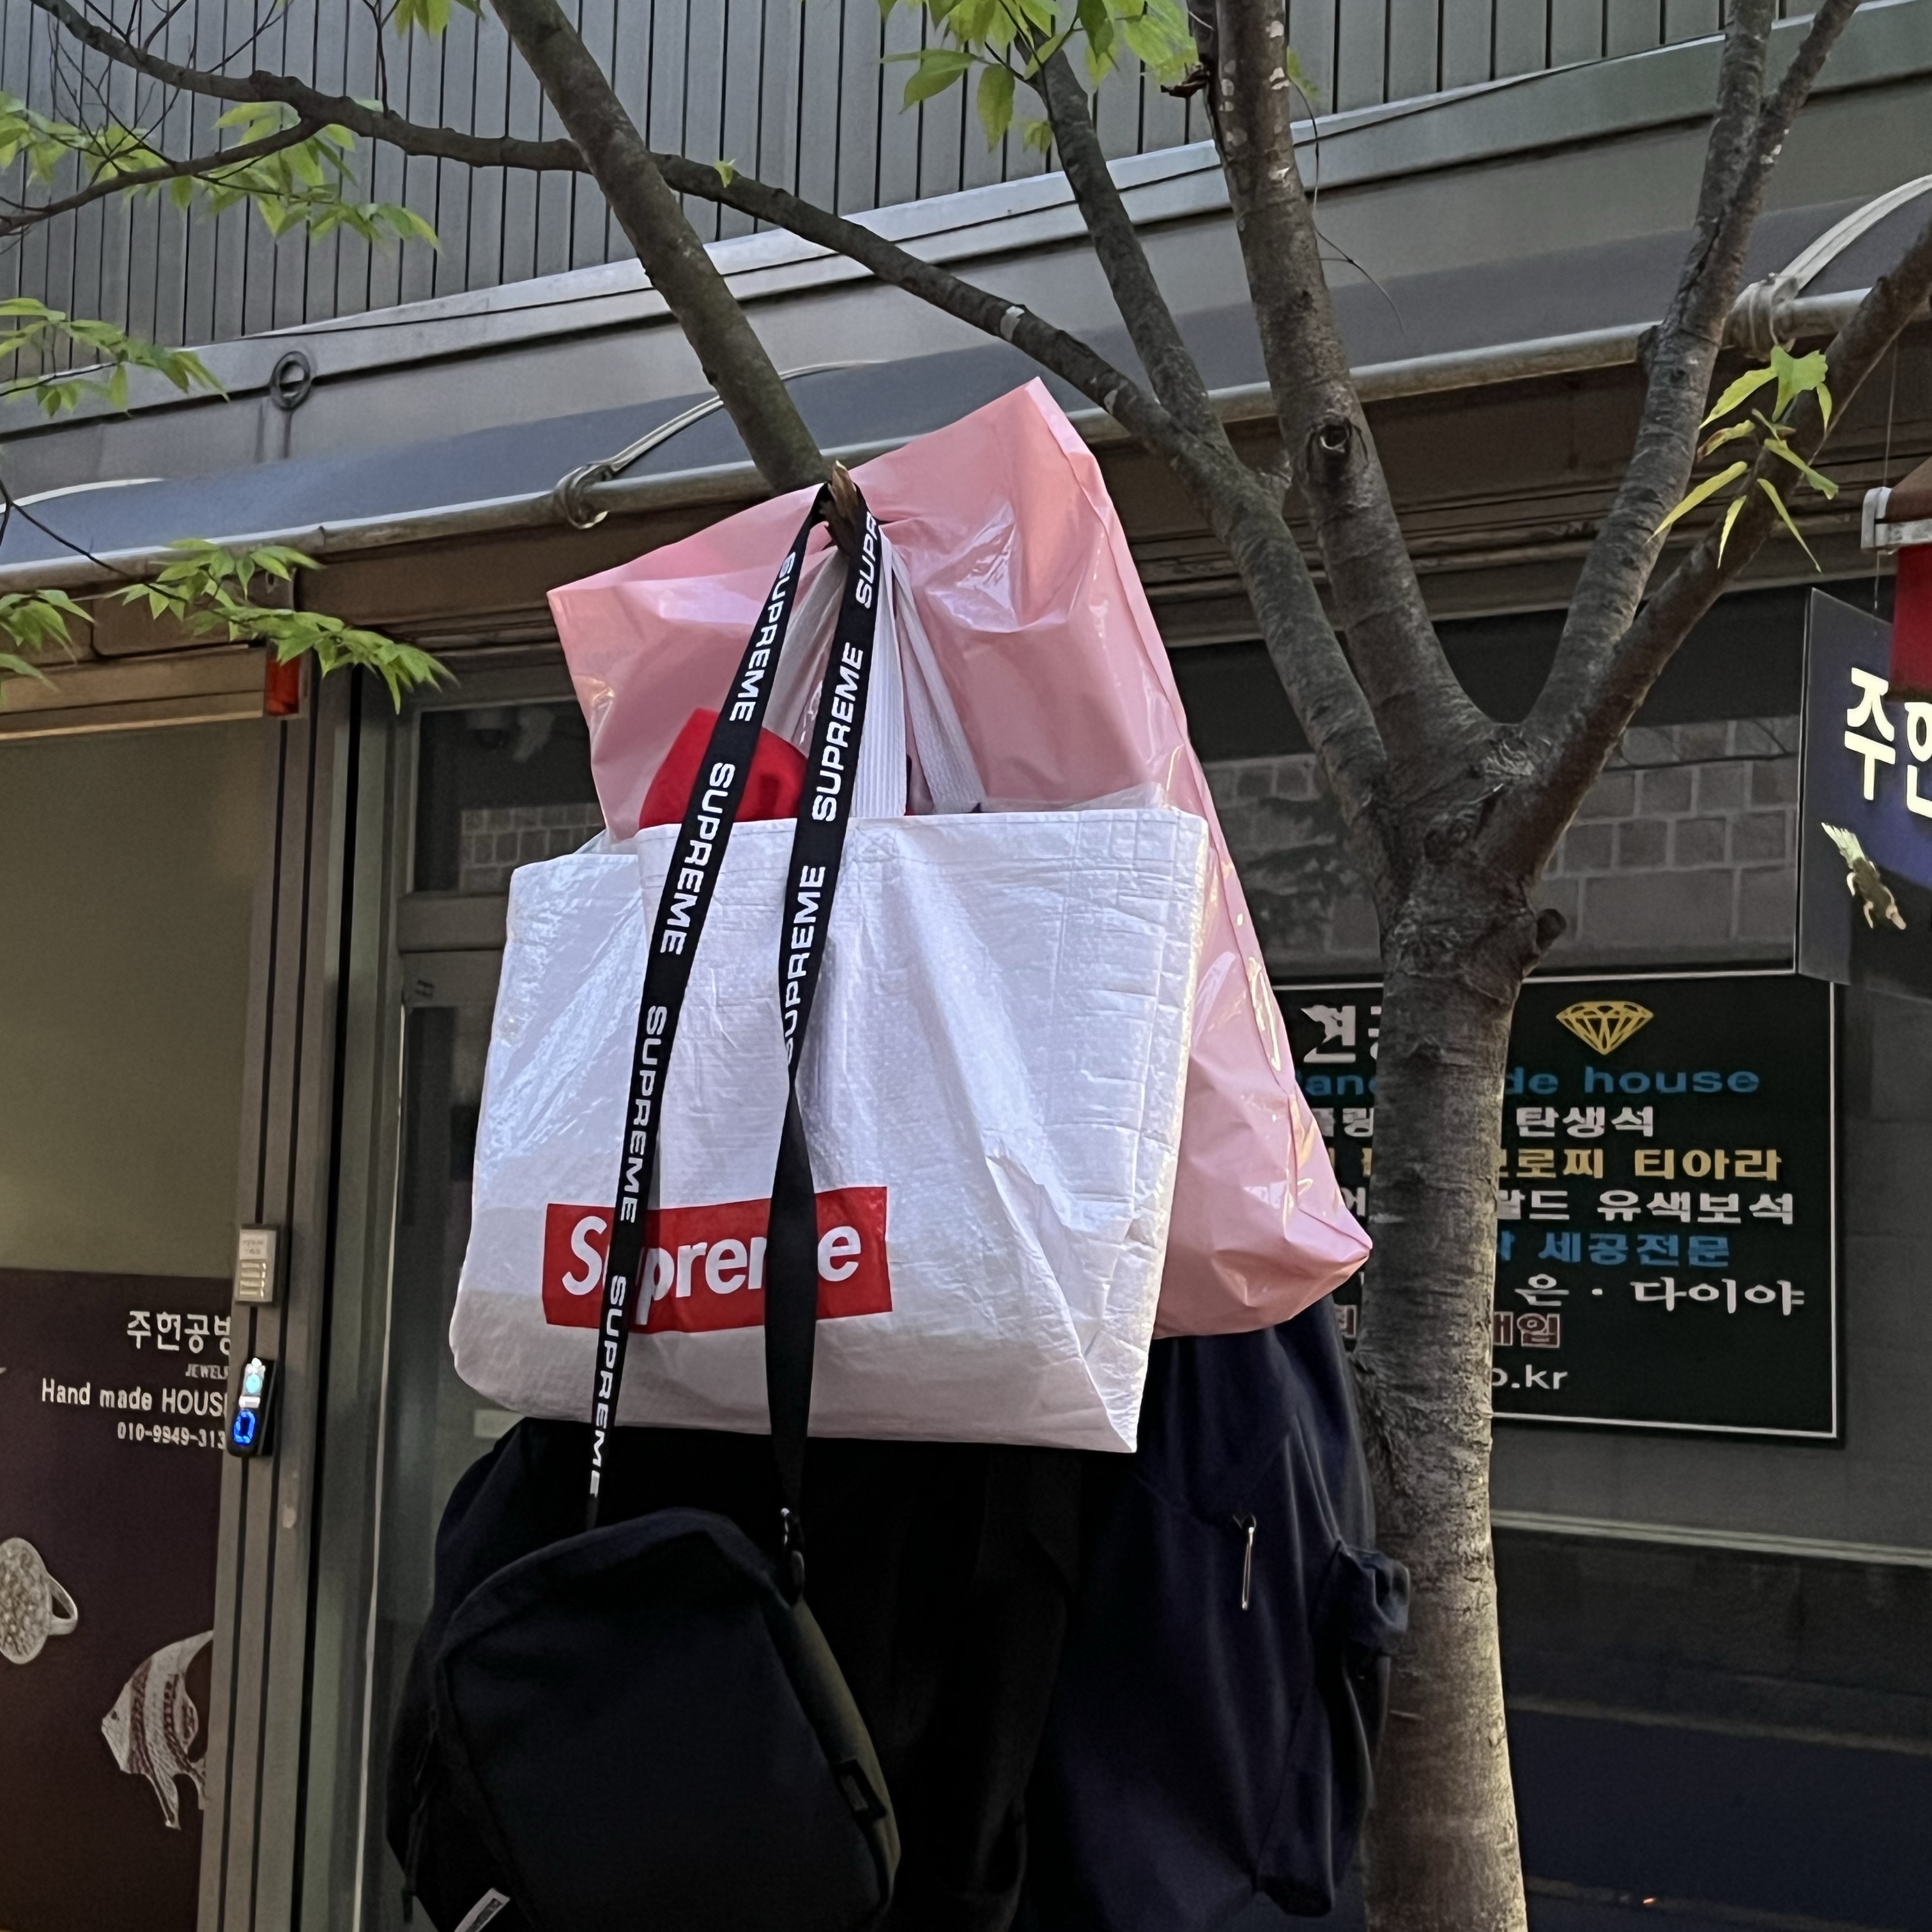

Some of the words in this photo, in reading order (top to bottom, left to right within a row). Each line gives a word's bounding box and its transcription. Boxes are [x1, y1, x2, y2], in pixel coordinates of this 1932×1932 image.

[729, 551, 796, 723] SUPREME
[811, 642, 864, 822] SUPREME
[660, 762, 735, 955] SUPREME
[1584, 1065, 1760, 1094] house
[620, 1005, 668, 1223] SUPREME
[1515, 1106, 1653, 1138] 탄생석
[1634, 1149, 1782, 1181] 티아라
[1597, 1190, 1793, 1225] 유색보석
[1538, 1232, 1729, 1268] 세공전문
[562, 1215, 862, 1326] Spree
[1630, 1276, 1805, 1316] 다이야
[42, 1377, 91, 1406] Hand
[100, 1386, 153, 1411] made
[162, 1388, 227, 1417] HOUS
